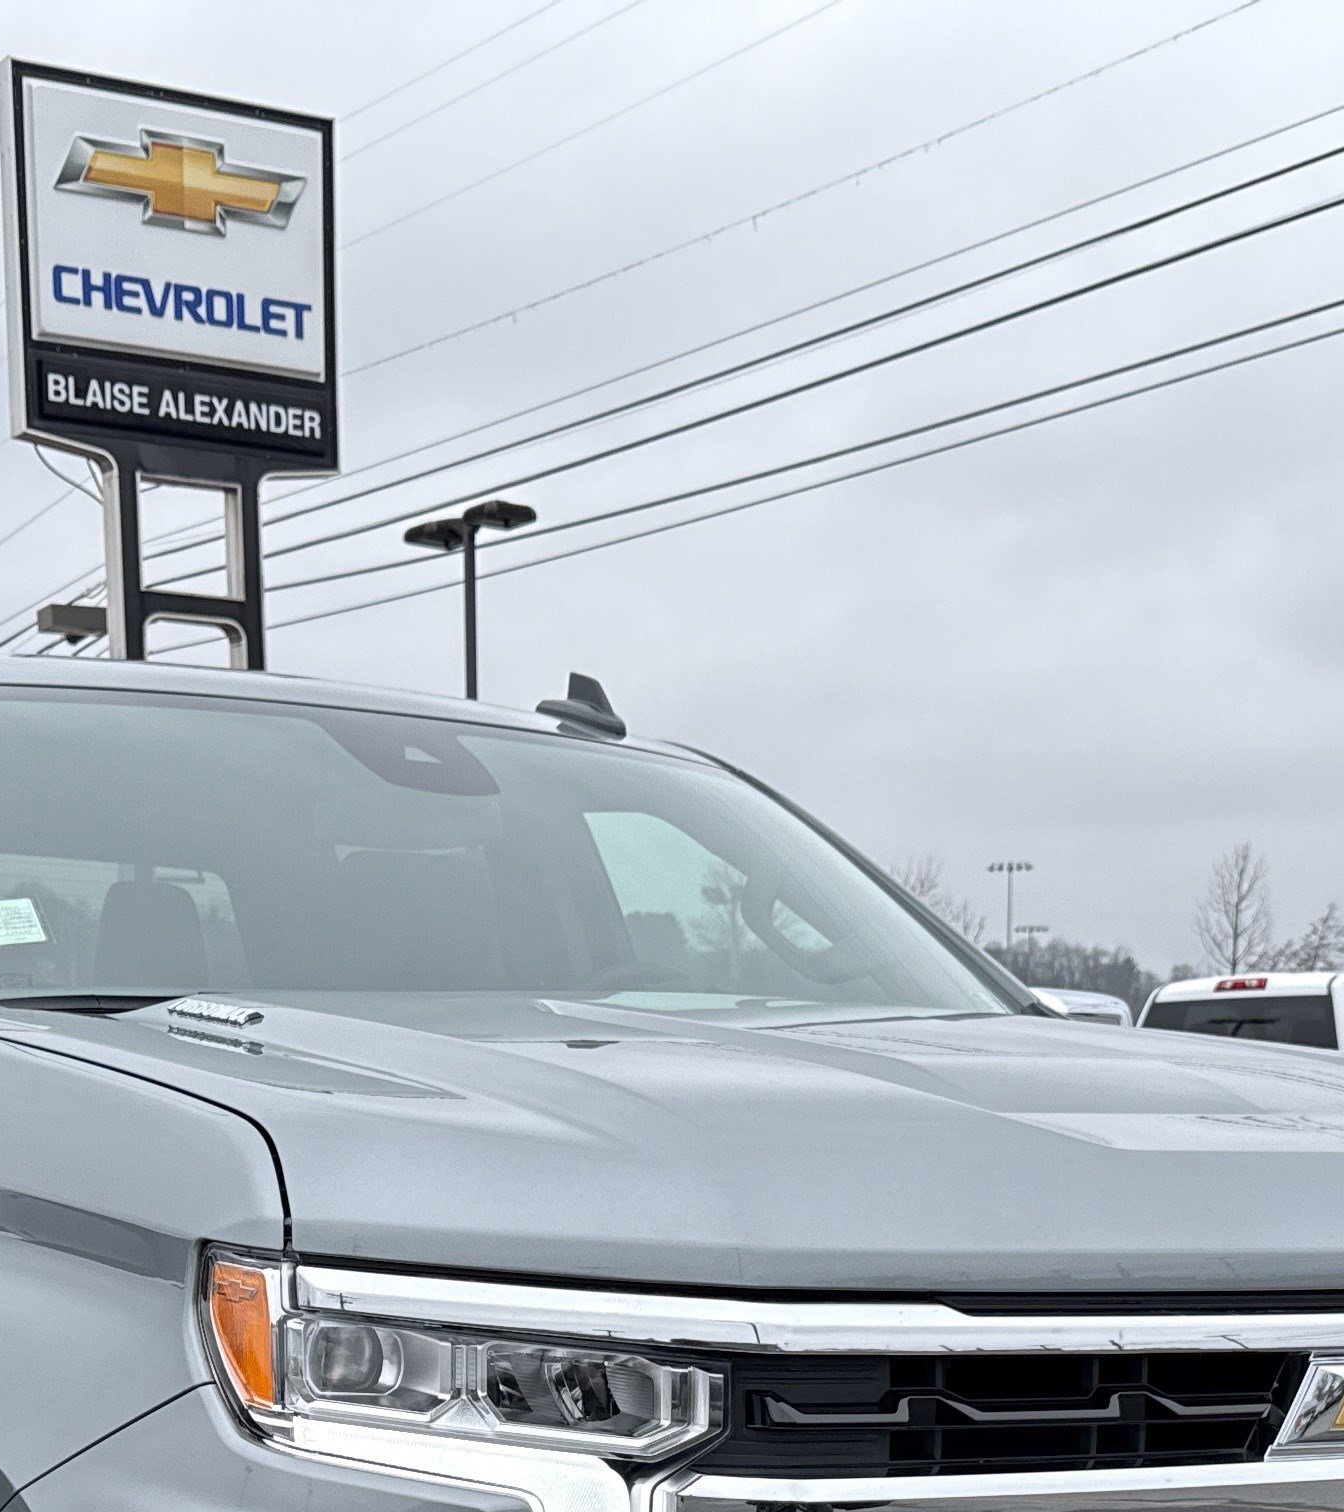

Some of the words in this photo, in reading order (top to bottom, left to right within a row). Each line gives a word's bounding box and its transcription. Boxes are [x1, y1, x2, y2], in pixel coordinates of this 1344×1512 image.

[52, 264, 312, 340] CHEVROLET
[46, 373, 151, 415] BLAISE
[158, 390, 322, 439] ALEXANDER
